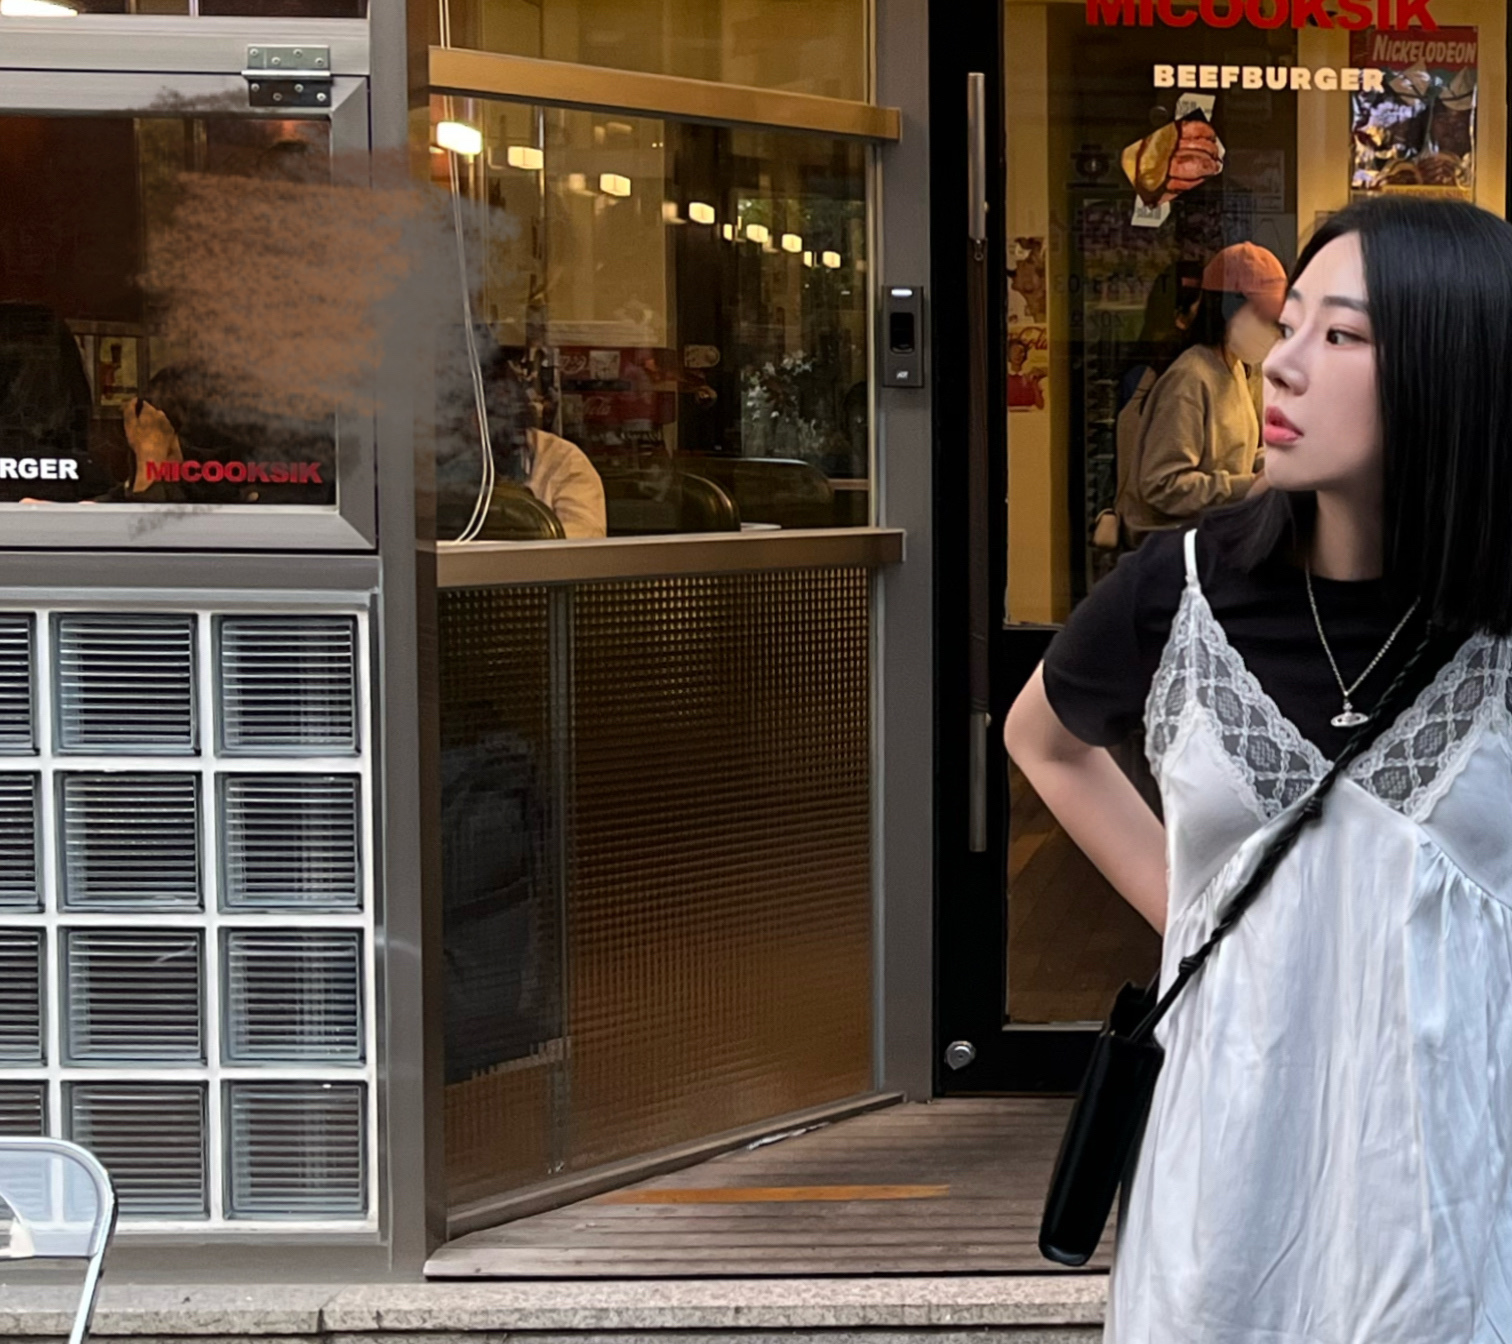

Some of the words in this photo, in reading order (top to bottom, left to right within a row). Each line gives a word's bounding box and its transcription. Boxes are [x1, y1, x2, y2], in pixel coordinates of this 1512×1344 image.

[1373, 34, 1477, 64] NICKELODEON
[1153, 64, 1386, 93] BEEFBURGER
[146, 460, 322, 483] MICOOKSIK
